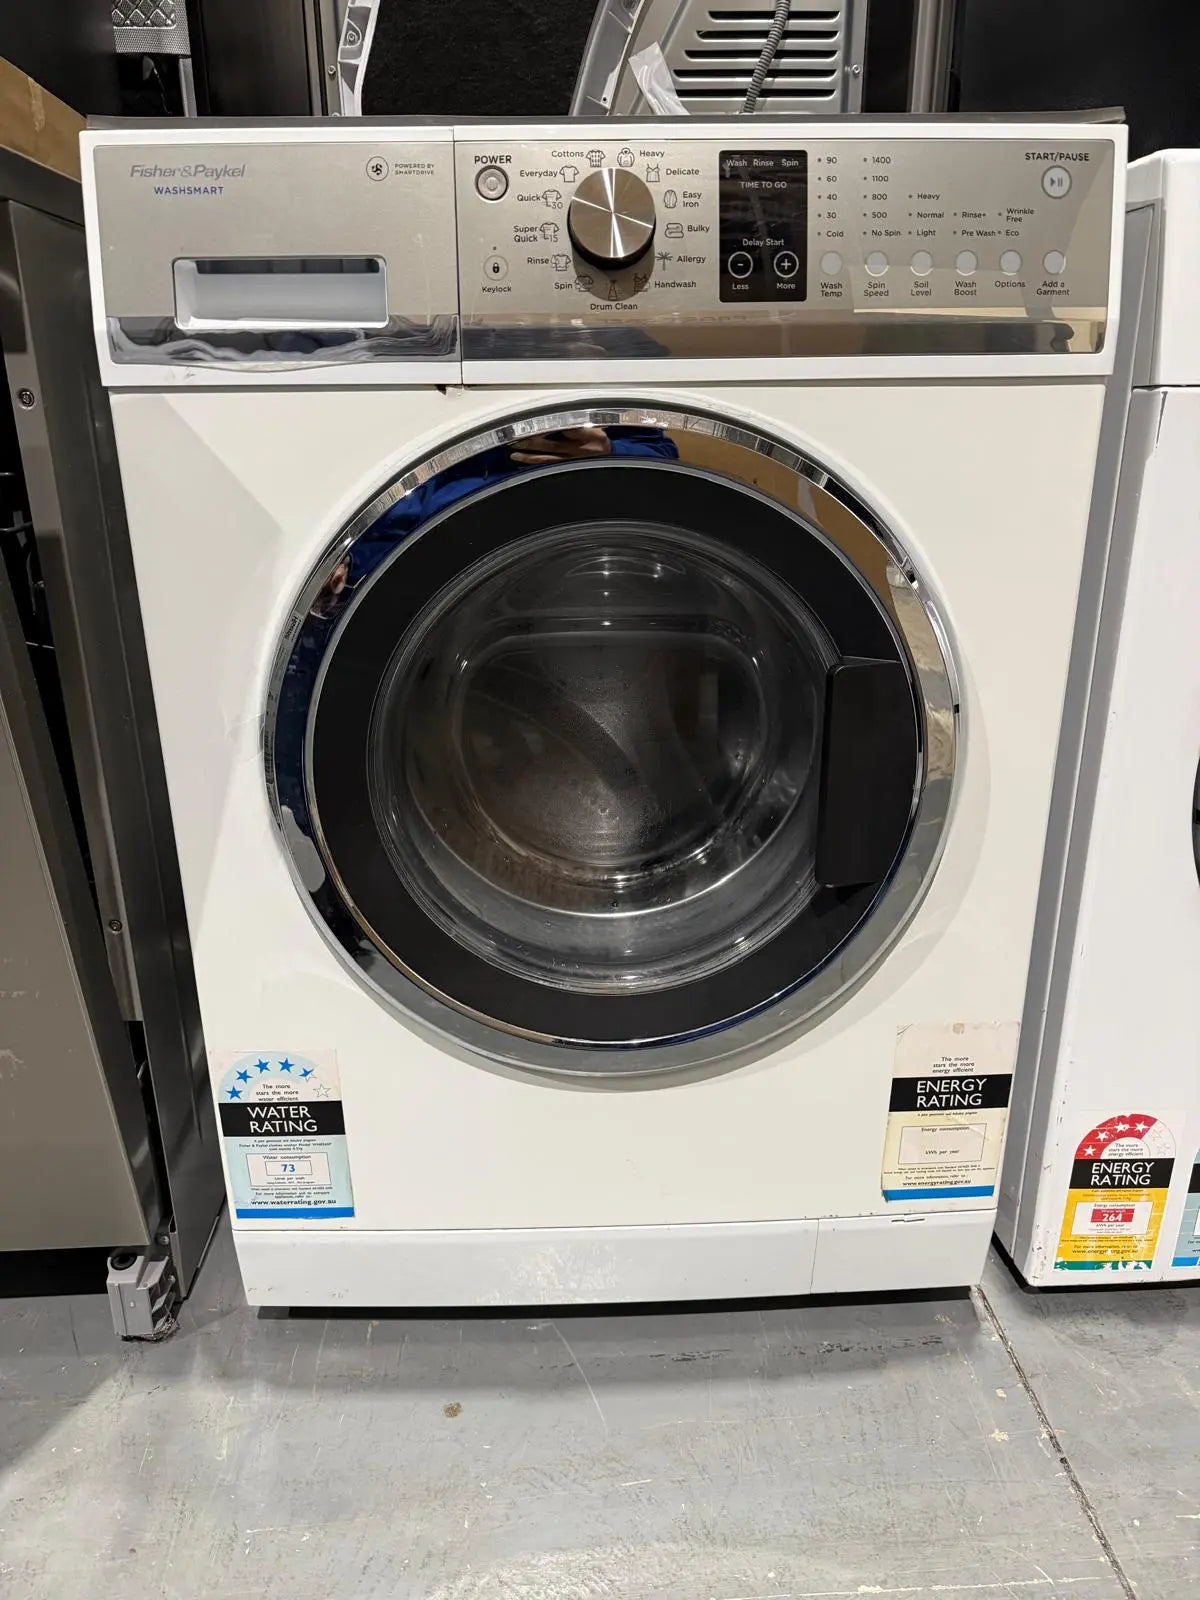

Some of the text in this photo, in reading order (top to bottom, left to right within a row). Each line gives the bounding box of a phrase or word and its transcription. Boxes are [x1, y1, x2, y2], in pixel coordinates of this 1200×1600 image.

[551, 150, 584, 158] Cottons
[640, 150, 665, 158] Heavy
[1025, 152, 1090, 161] START/PAUSE
[474, 155, 512, 164] POWER
[781, 159, 799, 167] Spin
[826, 156, 838, 164] 90
[872, 156, 891, 164] 1400
[520, 170, 558, 178] Everyday
[666, 168, 700, 176] Delicate
[740, 181, 787, 189] TIME TO GO
[154, 186, 224, 195] WASHSMART
[517, 194, 541, 202] Quick
[683, 191, 702, 199] Easy
[513, 225, 539, 234] Super
[687, 225, 710, 233] Bulky
[917, 229, 936, 237] Light
[513, 235, 538, 243] Quick
[742, 238, 785, 247] Delay Start
[677, 255, 706, 264] Allergy
[916, 1078, 988, 1093] ENERGY
[916, 1093, 982, 1108] RATING
[247, 1106, 311, 1118] WATER
[249, 1119, 318, 1133] RATING
[281, 1164, 295, 1172] 73
[1092, 1162, 1155, 1174] ENERGY
[1090, 1174, 1151, 1186] RATING
[1102, 1214, 1122, 1222] 264
